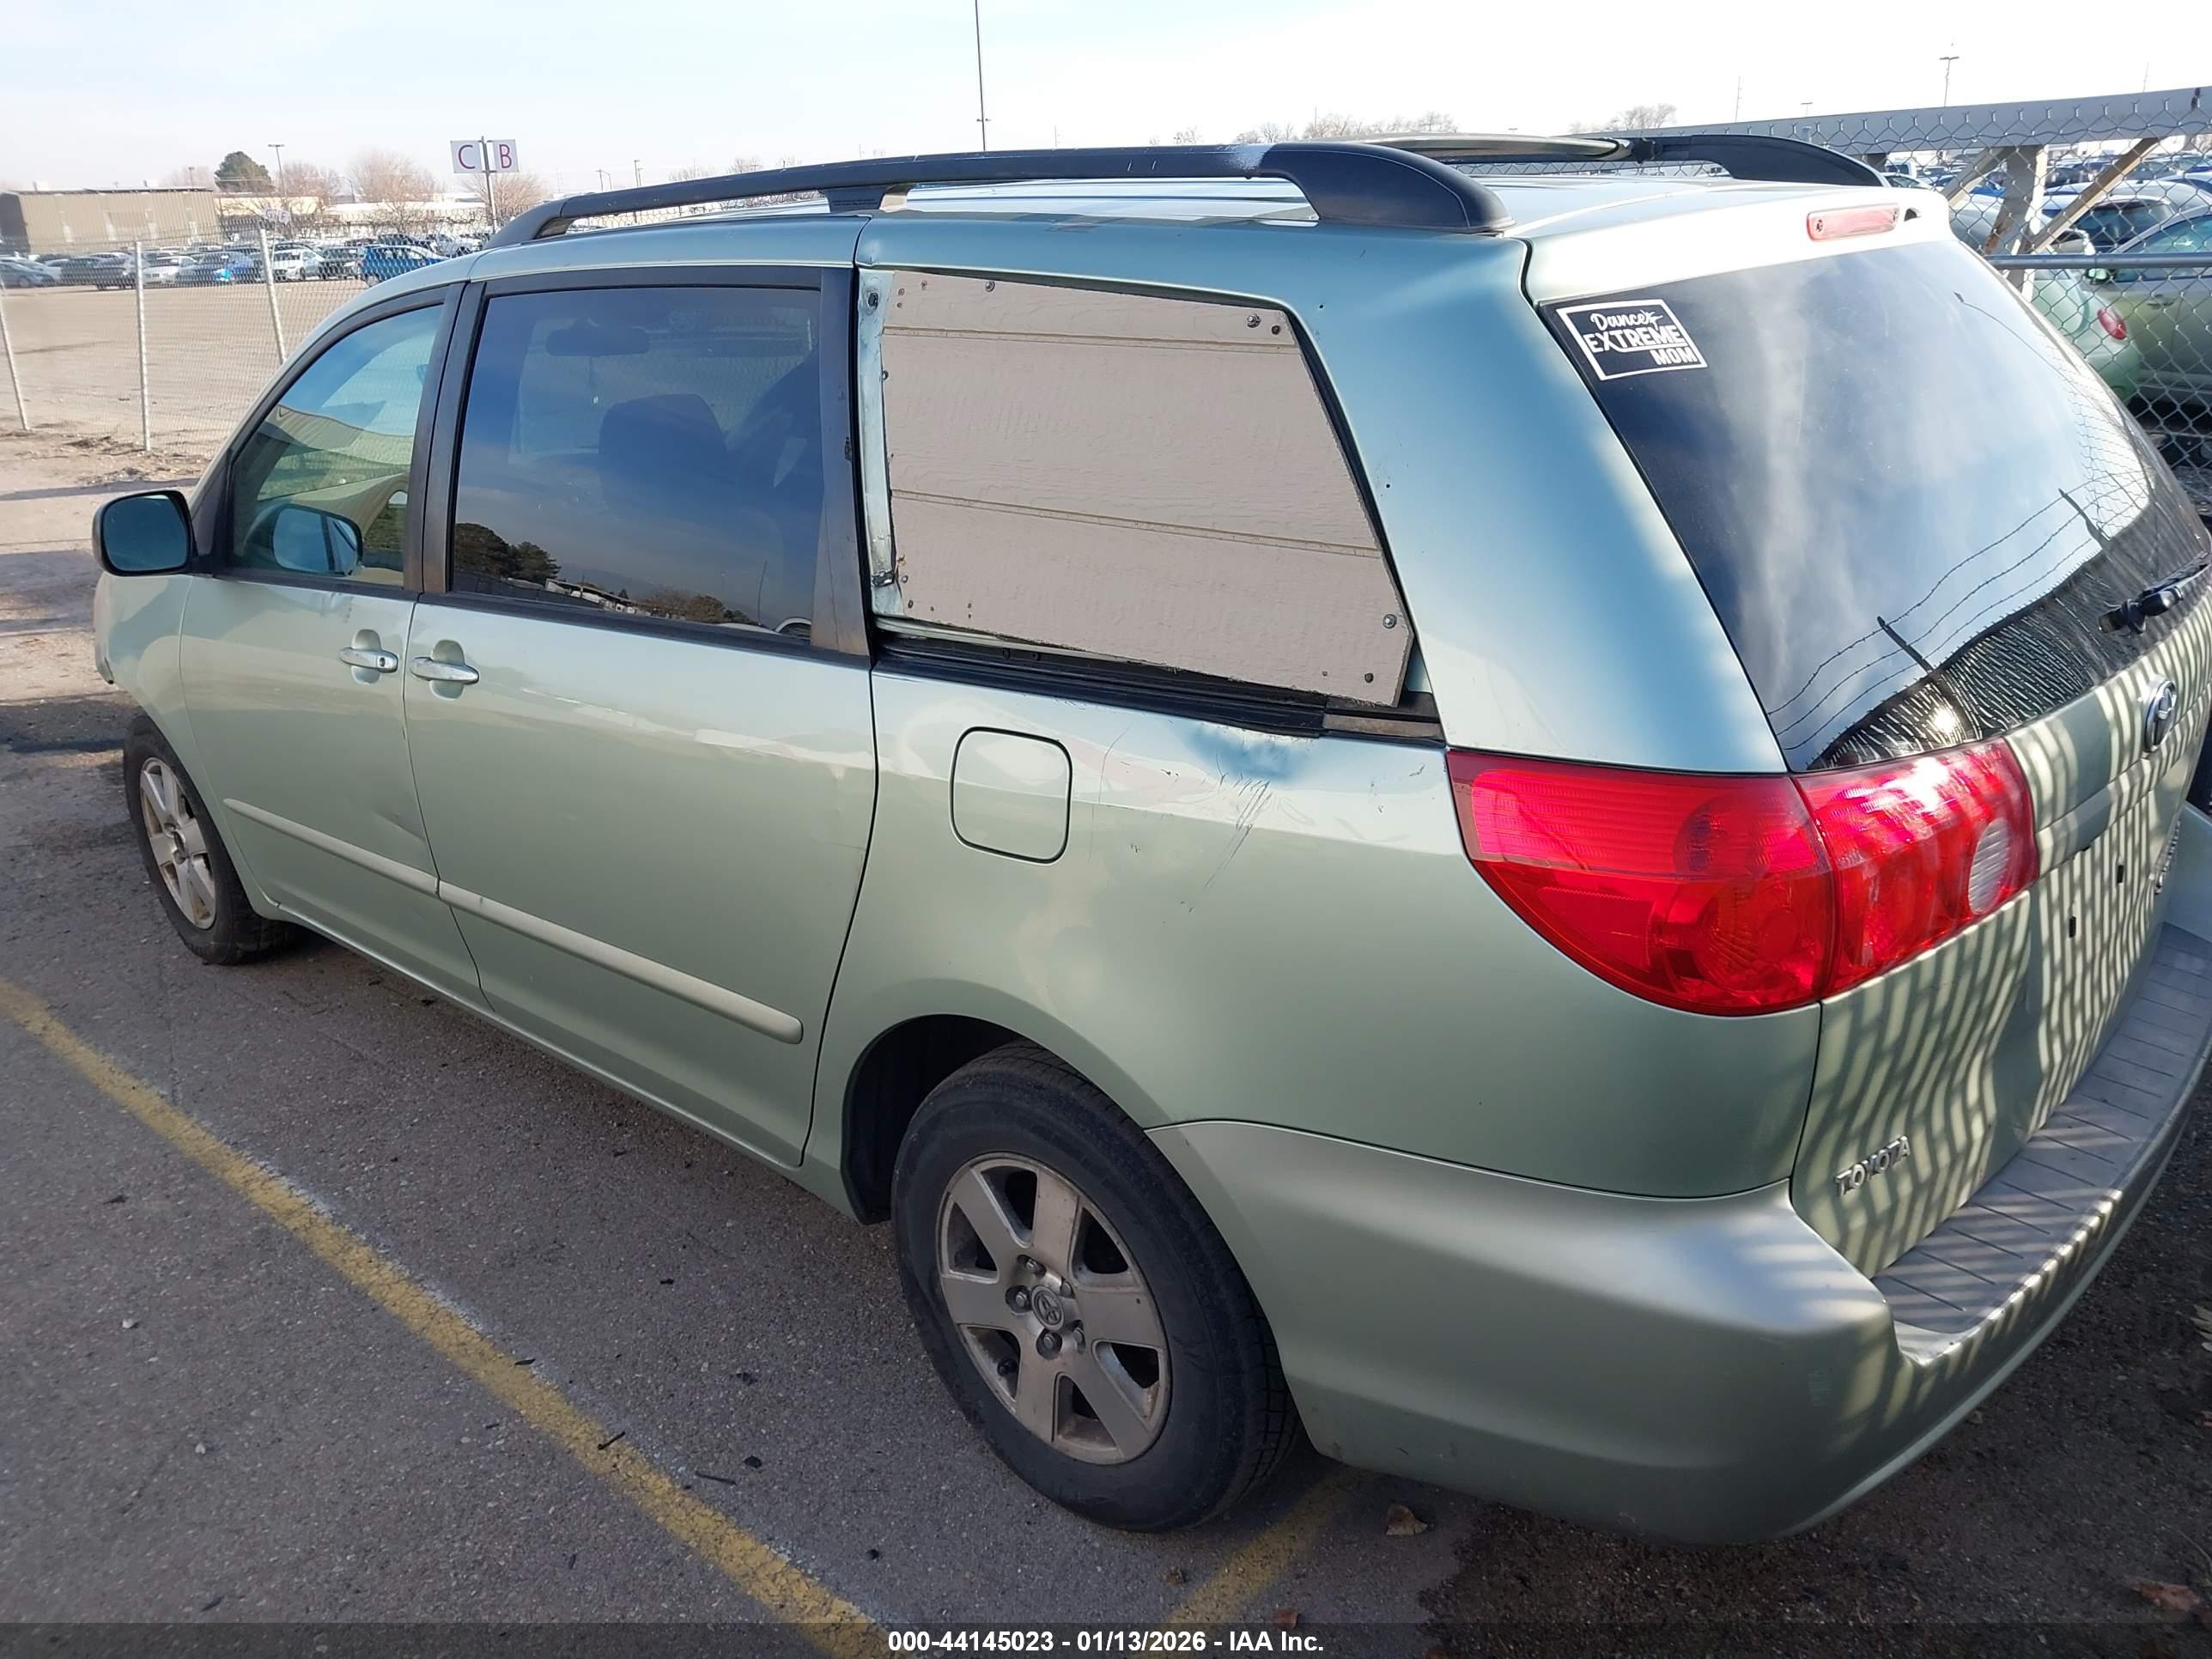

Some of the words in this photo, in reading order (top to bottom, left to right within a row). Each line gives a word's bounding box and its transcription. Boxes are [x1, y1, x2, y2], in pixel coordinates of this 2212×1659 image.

[458, 144, 476, 169] C
[499, 144, 513, 168] B
[1583, 325, 1686, 353] EXTREME
[1649, 346, 1698, 365] MOM
[1834, 1135, 1911, 1195] TOYOTA
